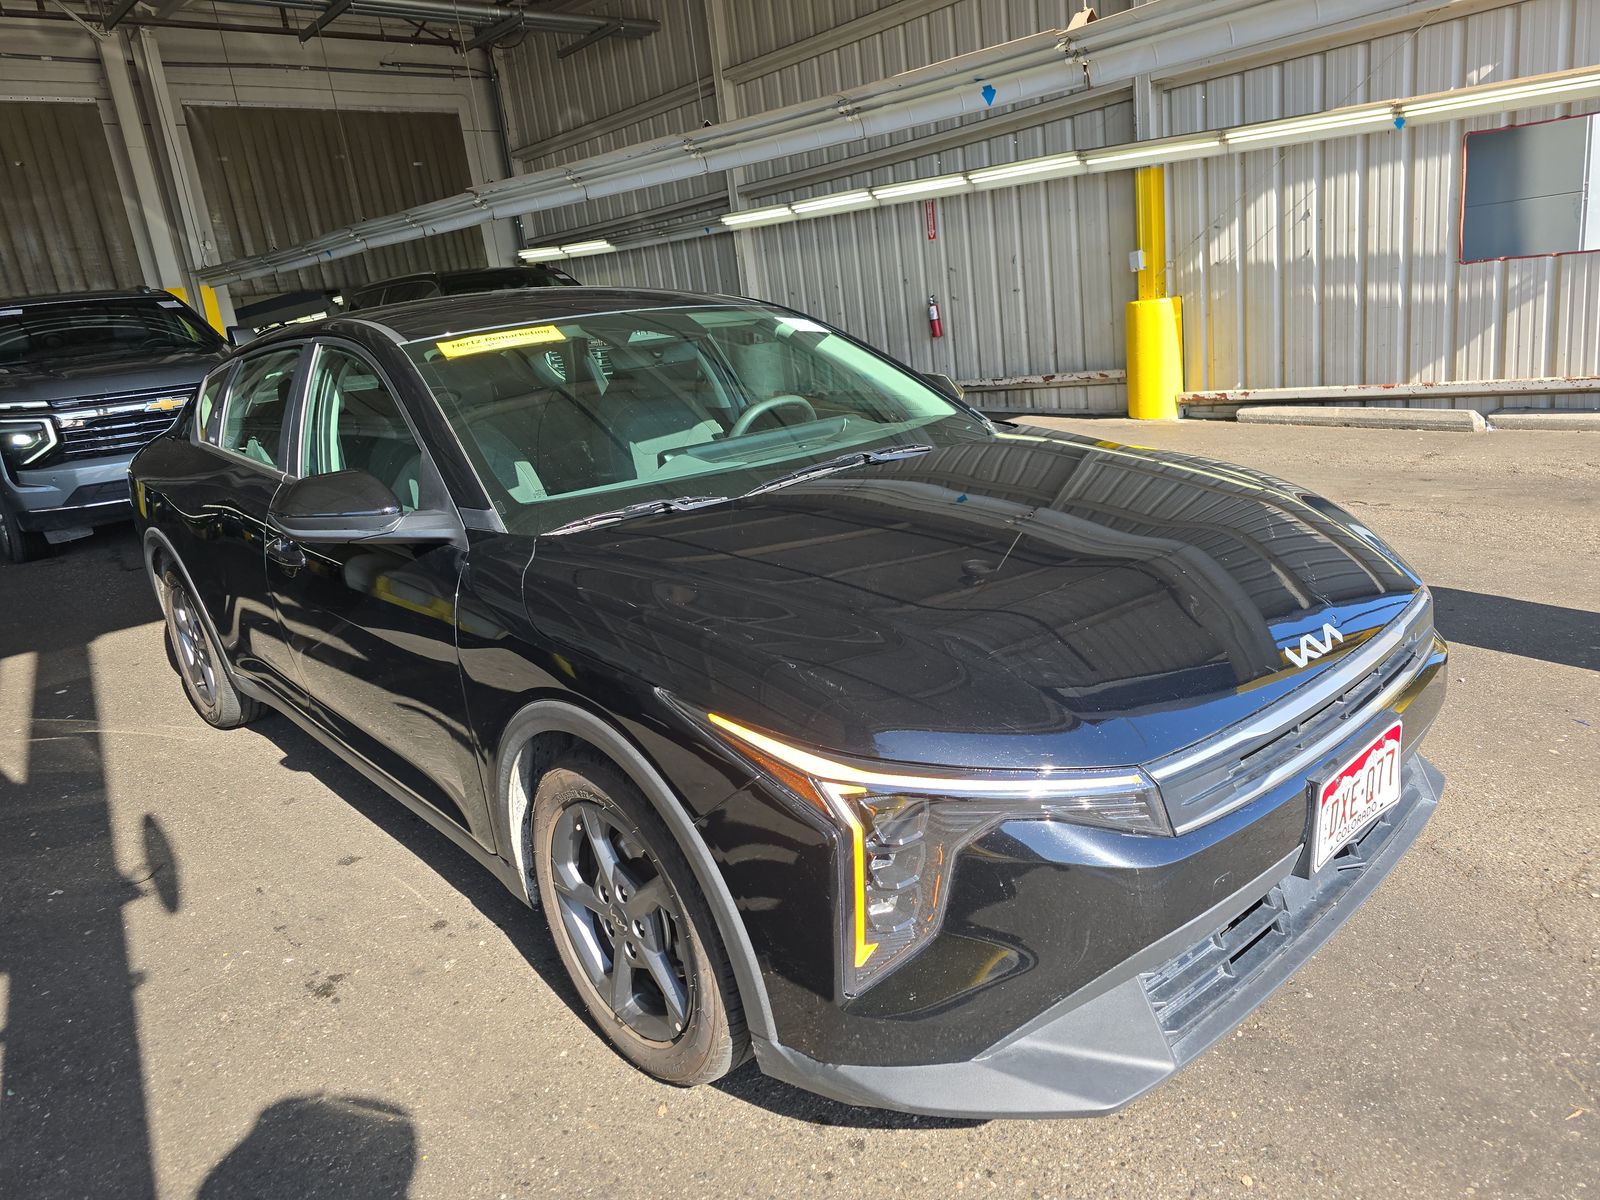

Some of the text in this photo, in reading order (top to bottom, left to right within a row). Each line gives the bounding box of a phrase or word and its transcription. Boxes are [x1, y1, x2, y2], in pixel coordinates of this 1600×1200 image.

[451, 338, 481, 349] Hertz
[485, 328, 550, 341] Remarketing
[1336, 801, 1378, 843] COLORADO
